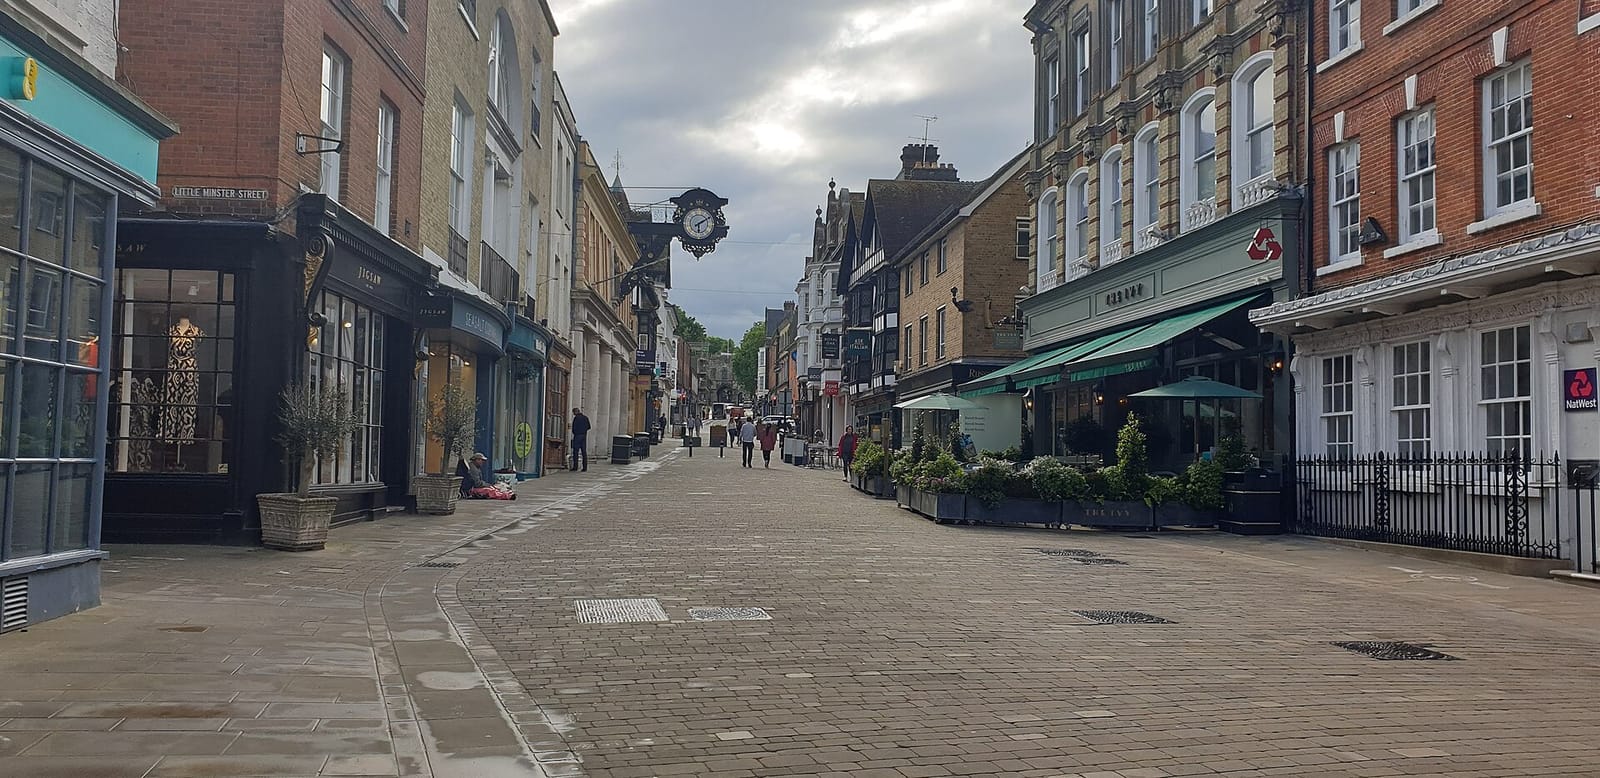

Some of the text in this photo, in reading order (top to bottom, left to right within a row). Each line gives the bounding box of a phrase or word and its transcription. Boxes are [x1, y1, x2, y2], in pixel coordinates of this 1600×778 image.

[174, 187, 266, 199] LITTLE MINSTER STREET
[358, 266, 382, 285] JIGSAW
[1106, 282, 1144, 305] THE IVY
[1566, 399, 1597, 409] NatWest
